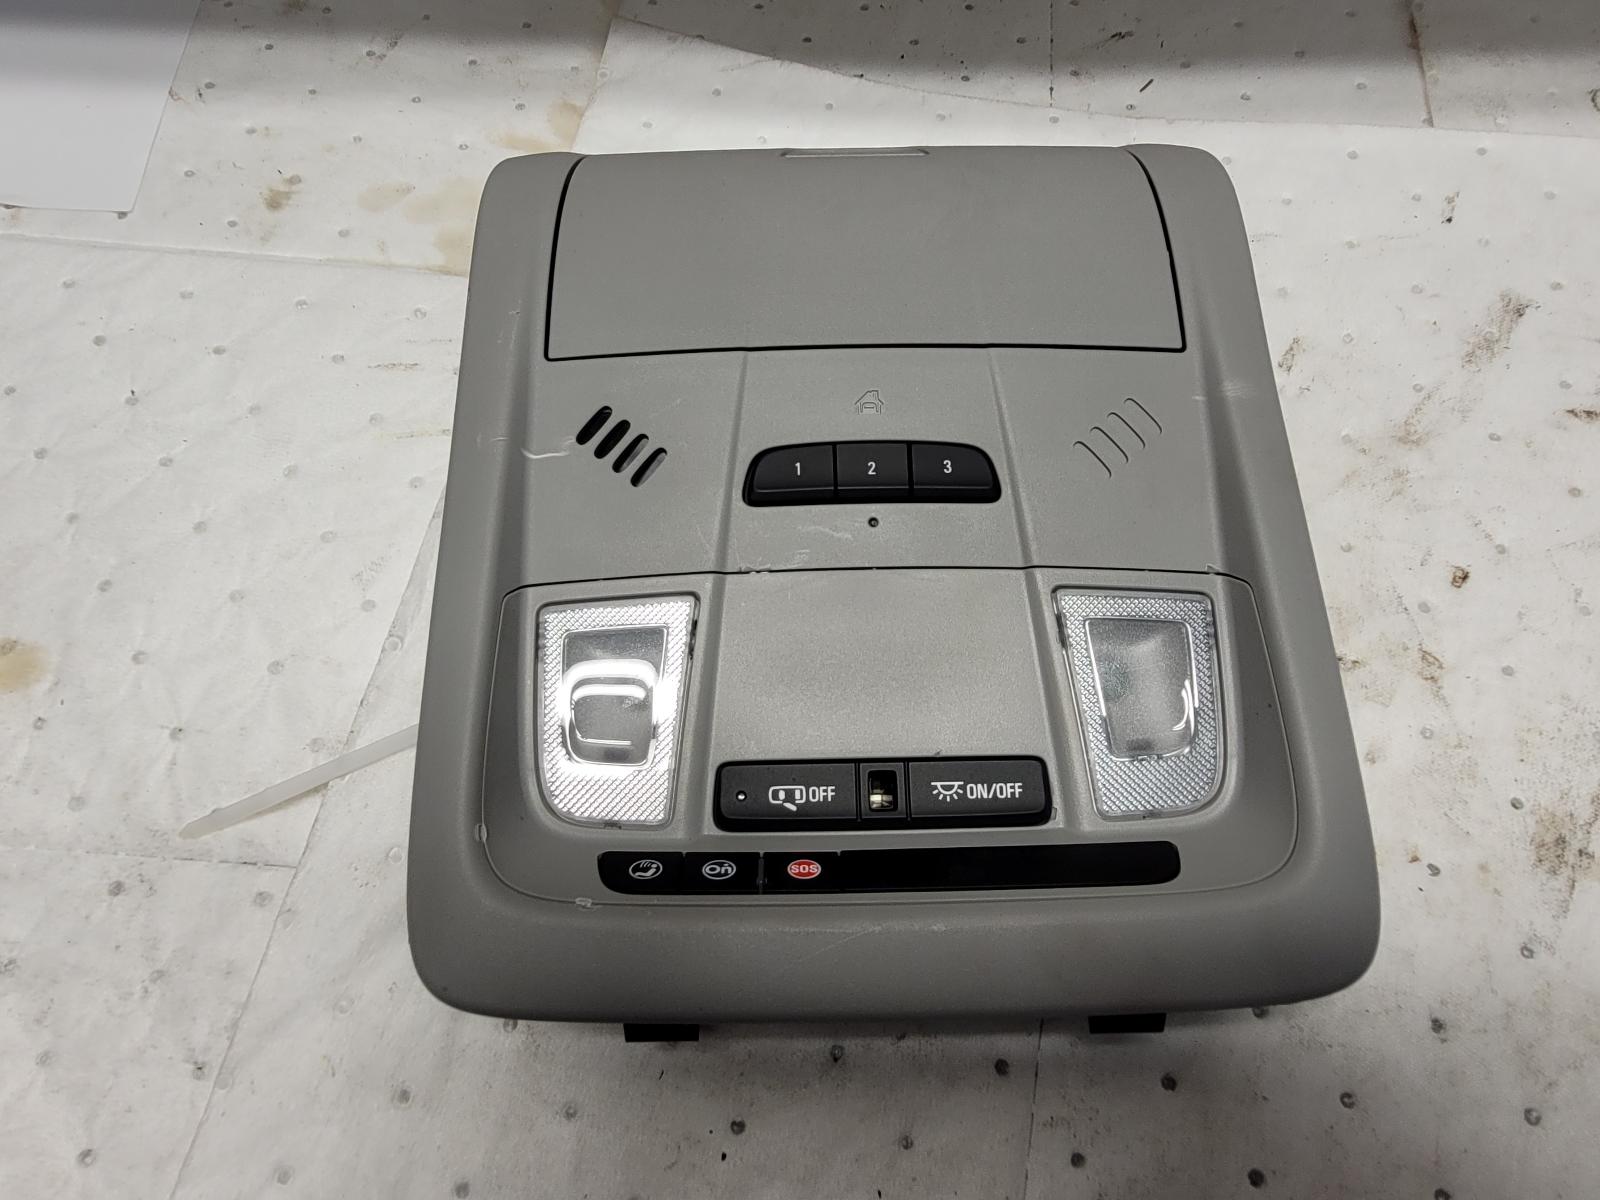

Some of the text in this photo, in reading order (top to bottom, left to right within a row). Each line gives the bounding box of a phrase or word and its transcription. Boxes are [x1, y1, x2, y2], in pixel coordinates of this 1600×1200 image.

[794, 462, 801, 476] 1
[867, 462, 877, 475] 2
[943, 460, 953, 474] 3
[808, 786, 836, 802] OFF
[966, 782, 1023, 800] ON/OFF
[790, 864, 818, 874] SOS
